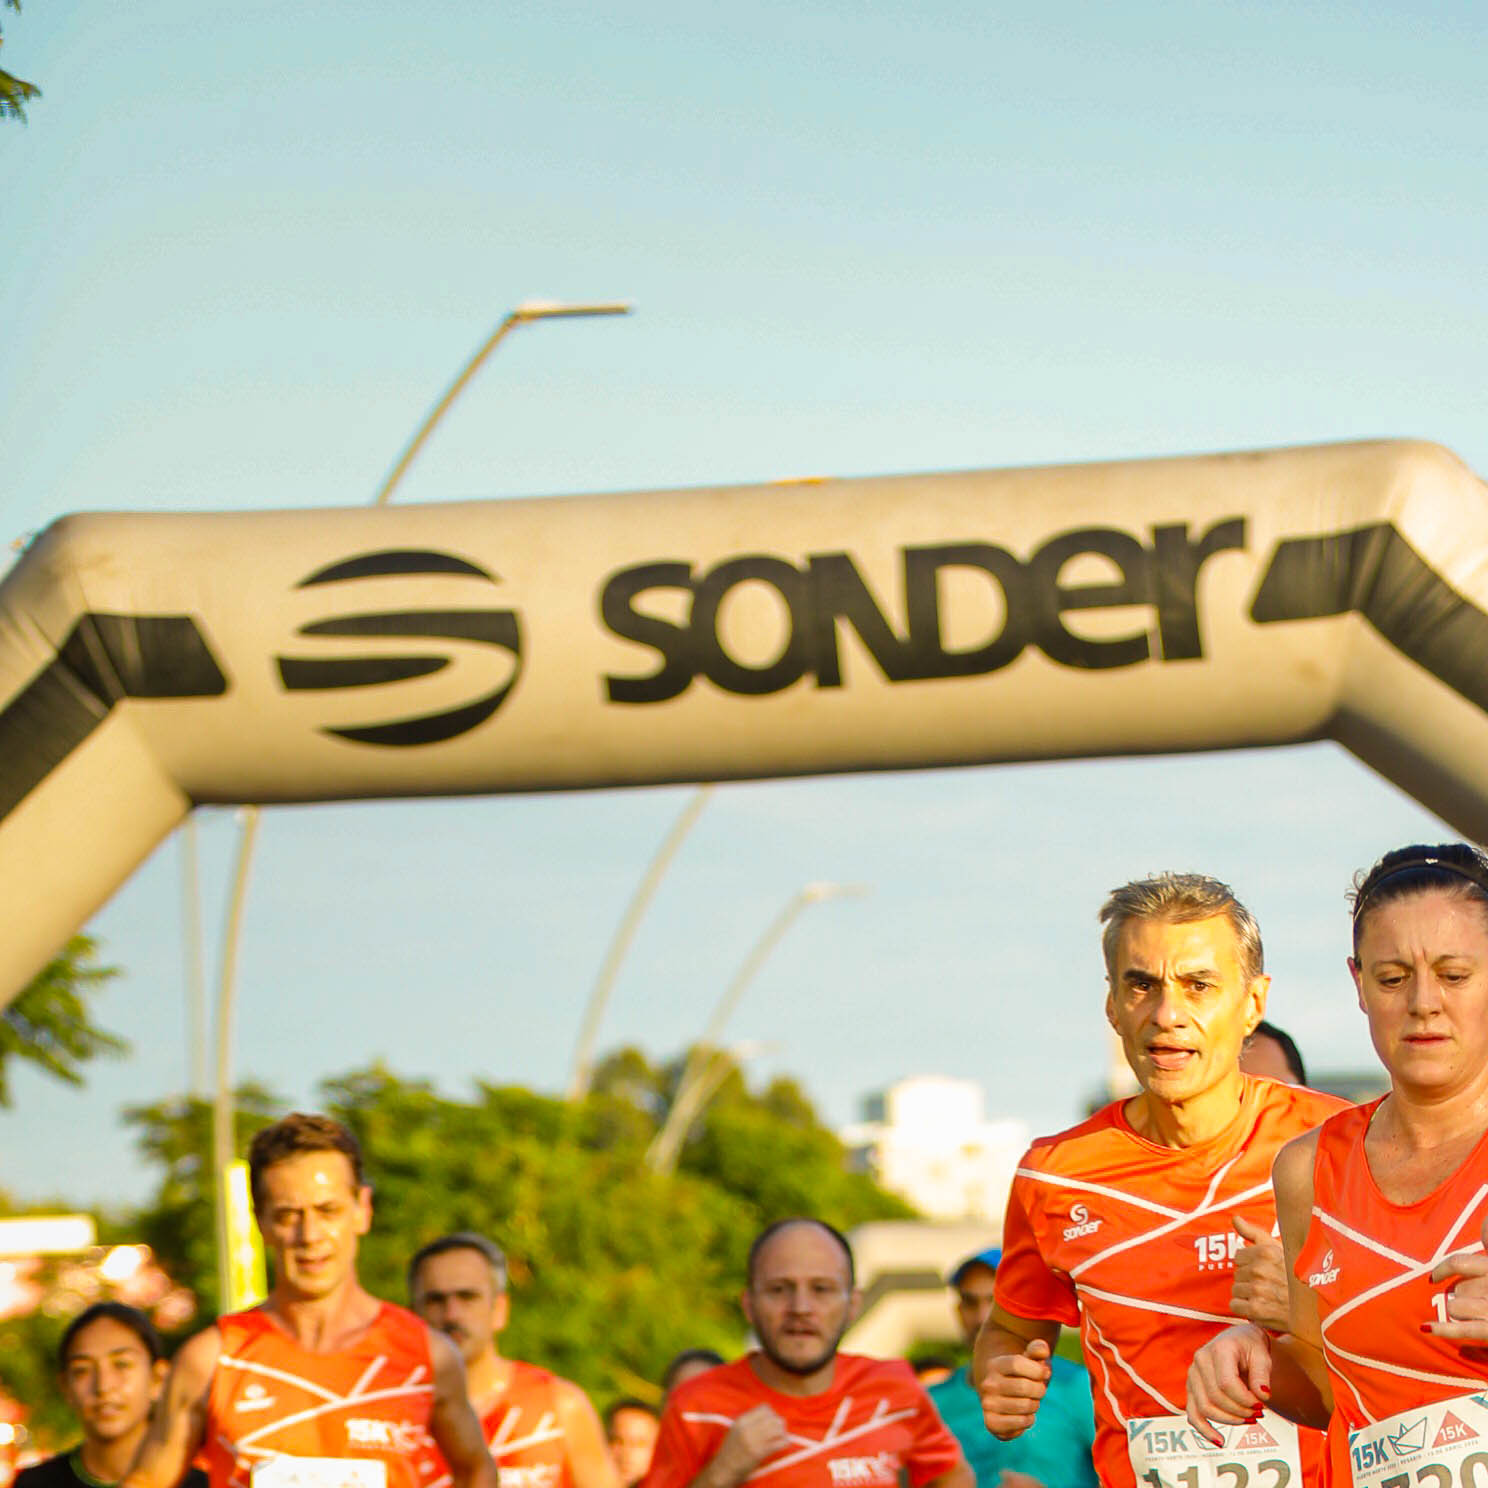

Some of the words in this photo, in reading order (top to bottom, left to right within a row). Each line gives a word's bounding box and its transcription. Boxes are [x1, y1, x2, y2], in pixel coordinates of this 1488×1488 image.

[1199, 1262, 1234, 1271] PUER
[1245, 1431, 1269, 1445] 15K
[1440, 1423, 1467, 1441] 15K
[1143, 1429, 1188, 1454] 15K
[1352, 1437, 1390, 1471] 15K
